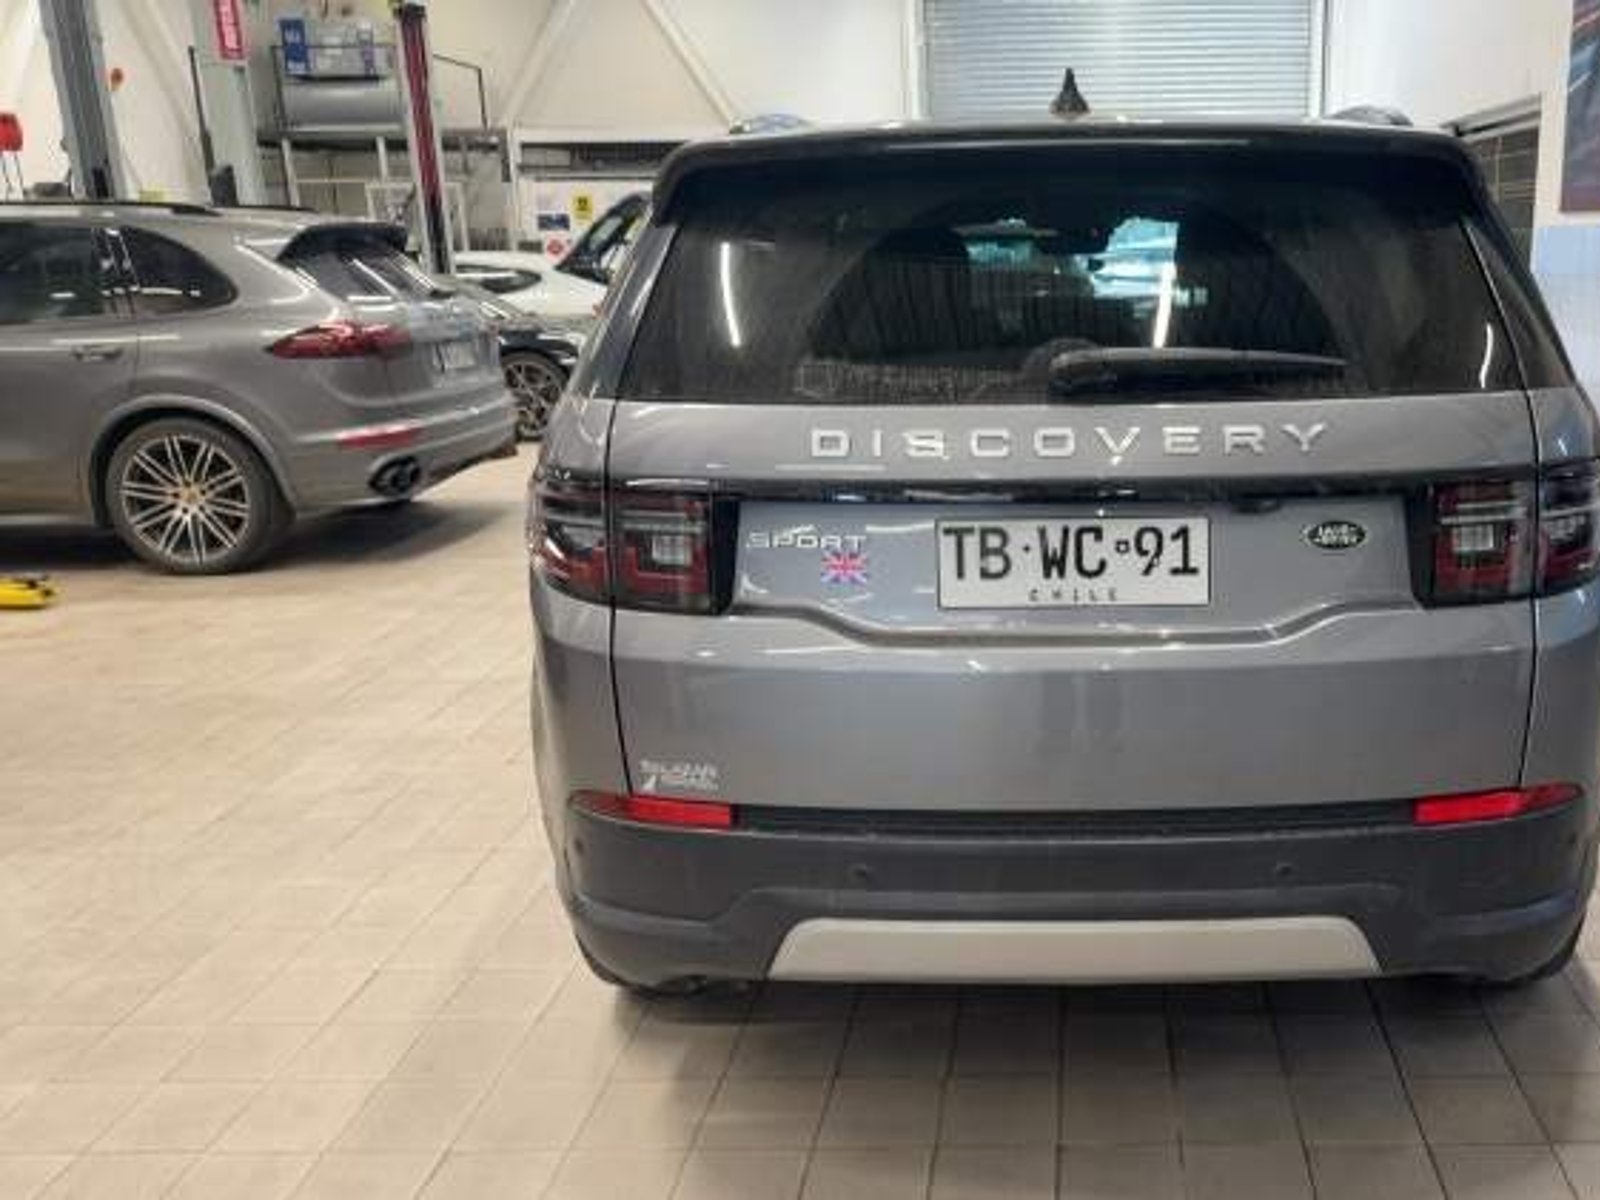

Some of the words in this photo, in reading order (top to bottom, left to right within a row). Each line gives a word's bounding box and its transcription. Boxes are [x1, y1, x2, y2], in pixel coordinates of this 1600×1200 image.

[811, 421, 1327, 459] DISCOVERY
[746, 531, 867, 551] SPORT
[1029, 588, 1118, 602] CHILE
